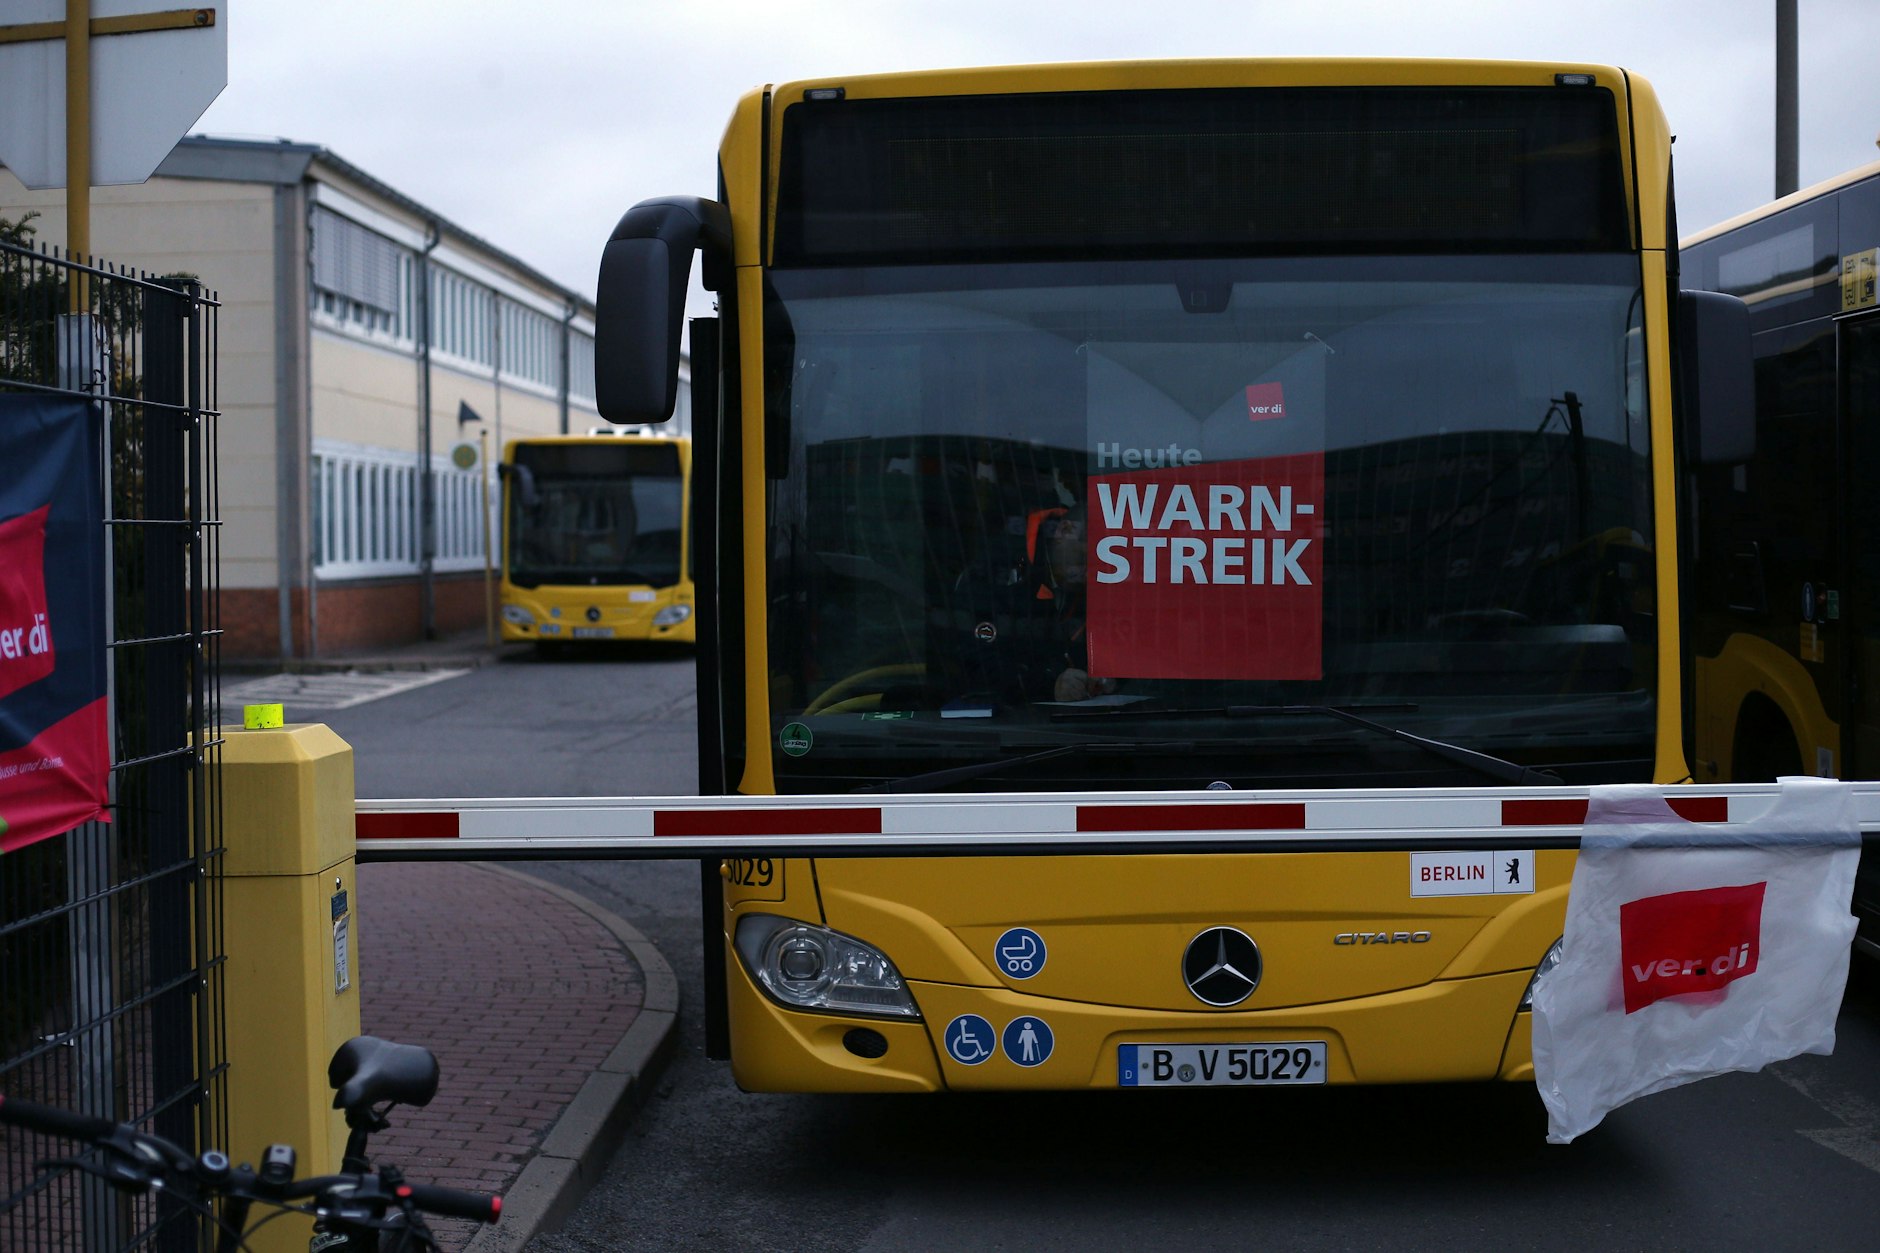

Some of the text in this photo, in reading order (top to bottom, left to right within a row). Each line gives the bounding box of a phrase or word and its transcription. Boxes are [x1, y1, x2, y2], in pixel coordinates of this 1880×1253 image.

[1096, 442, 1203, 469] Heute
[1096, 482, 1315, 532] WARN-
[1095, 535, 1313, 586] STREIK
[0, 613, 49, 660] er.di
[1420, 865, 1486, 882] BERLIN
[1333, 930, 1432, 946] CITARO
[1631, 942, 1750, 983] ver.di
[1124, 1048, 1312, 1081] D B V 5029
